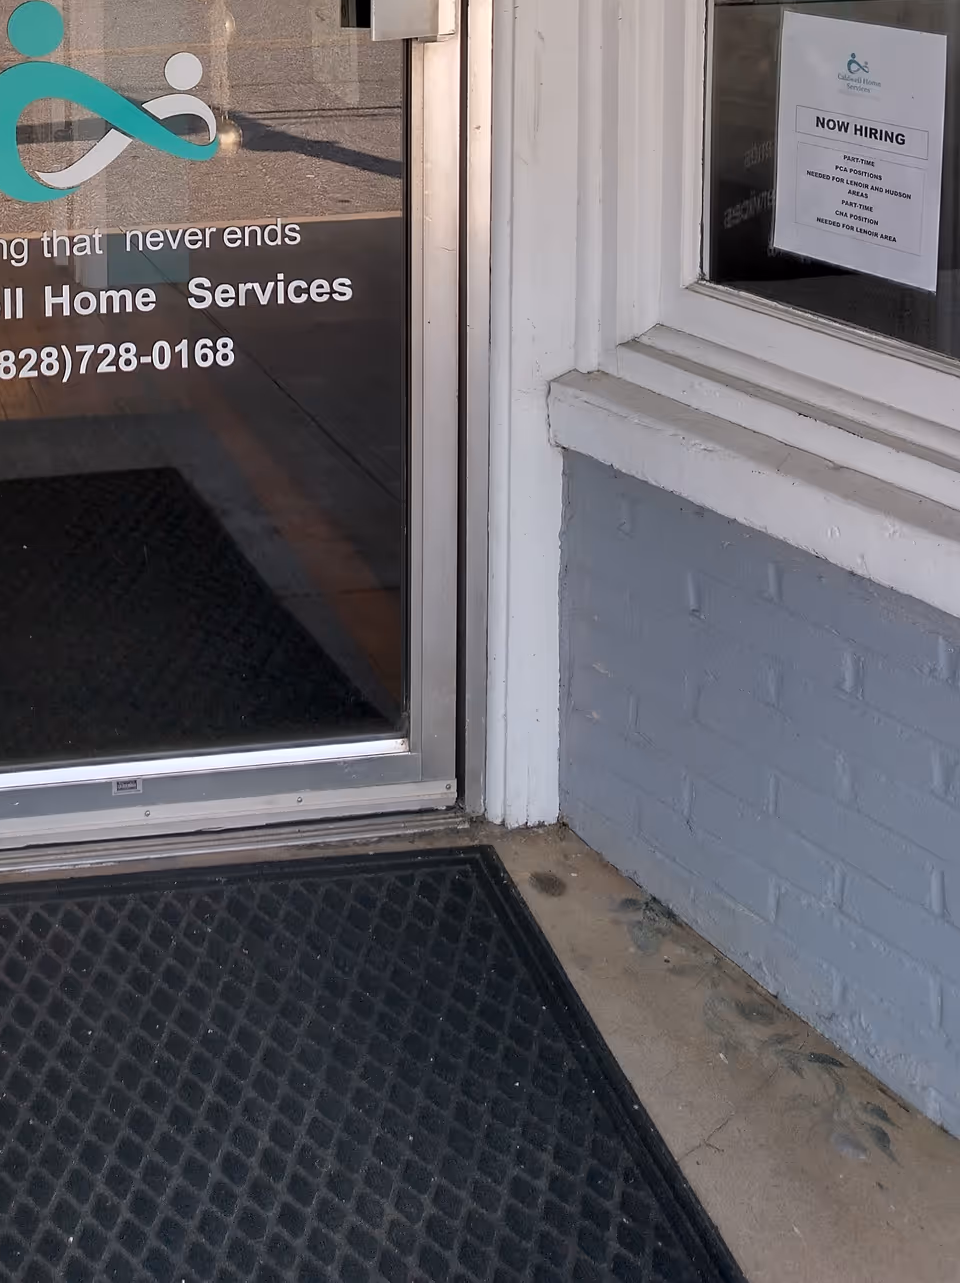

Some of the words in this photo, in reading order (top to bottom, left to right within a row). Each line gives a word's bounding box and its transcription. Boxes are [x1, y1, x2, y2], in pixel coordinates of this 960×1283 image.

[846, 83, 871, 93] Services
[815, 116, 850, 133] NOW
[854, 123, 906, 146] HIRING
[843, 154, 875, 167] PART-TIME
[835, 165, 848, 173] PCA
[849, 168, 882, 181] POSITIONS
[806, 170, 831, 181] NEEDED
[831, 176, 845, 184] FOR
[846, 179, 869, 190] LENOIR
[870, 185, 884, 193] AND
[885, 188, 912, 200] HUDSON
[847, 189, 869, 199] AREAS
[841, 199, 874, 212] PART-TIME
[849, 213, 879, 226] POSITION
[816, 217, 841, 228] NEEDED
[842, 223, 855, 231] FOR
[855, 227, 879, 238] LENOIR
[880, 233, 897, 243] AREA
[41, 227, 104, 259] that
[125, 225, 215, 252] never
[223, 218, 301, 248] ends
[45, 283, 157, 318] Home
[188, 272, 353, 309] Services
